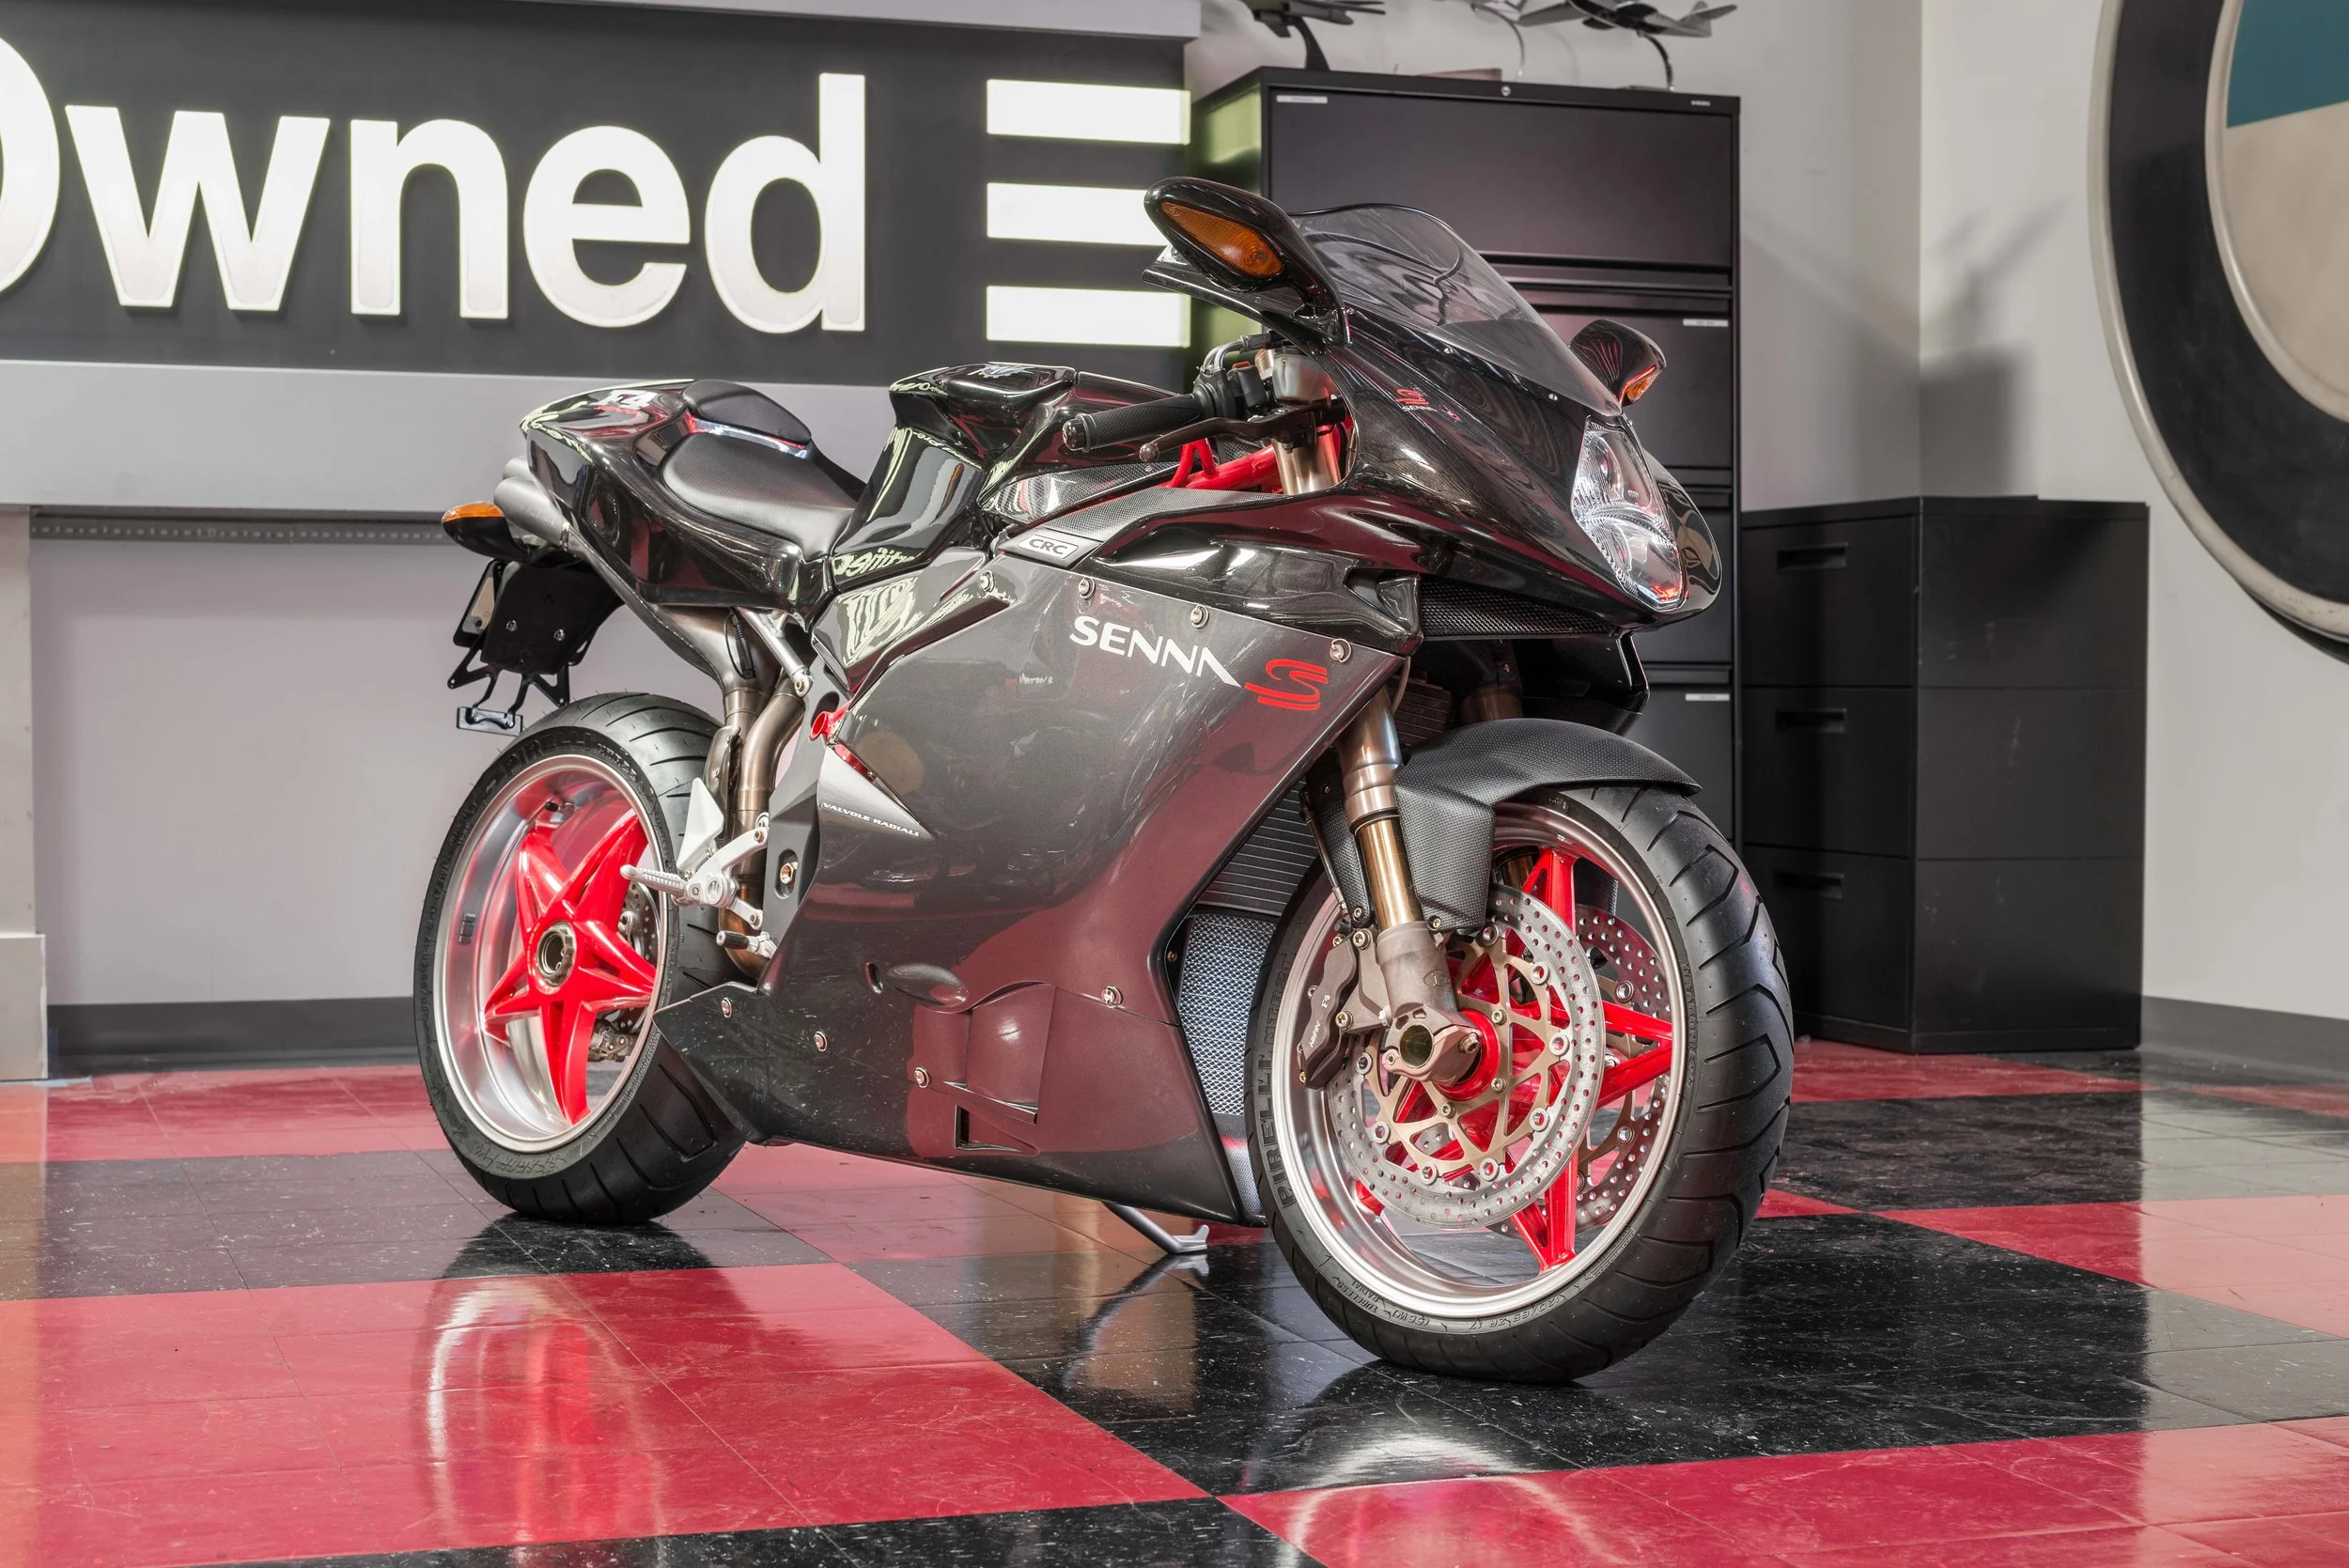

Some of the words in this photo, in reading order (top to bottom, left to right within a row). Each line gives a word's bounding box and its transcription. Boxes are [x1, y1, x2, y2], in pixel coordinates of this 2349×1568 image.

[0, 37, 865, 333] wned
[588, 389, 658, 411] F4
[1029, 538, 1067, 555] CRC
[1069, 615, 1241, 688] SENNA
[823, 802, 870, 821] VALVOLE
[873, 818, 920, 837] RADIALI
[1257, 1053, 1296, 1208] PIRELLI
[1337, 1281, 1377, 1312] TUBELESS
[1352, 1279, 1380, 1303] RADIAL
